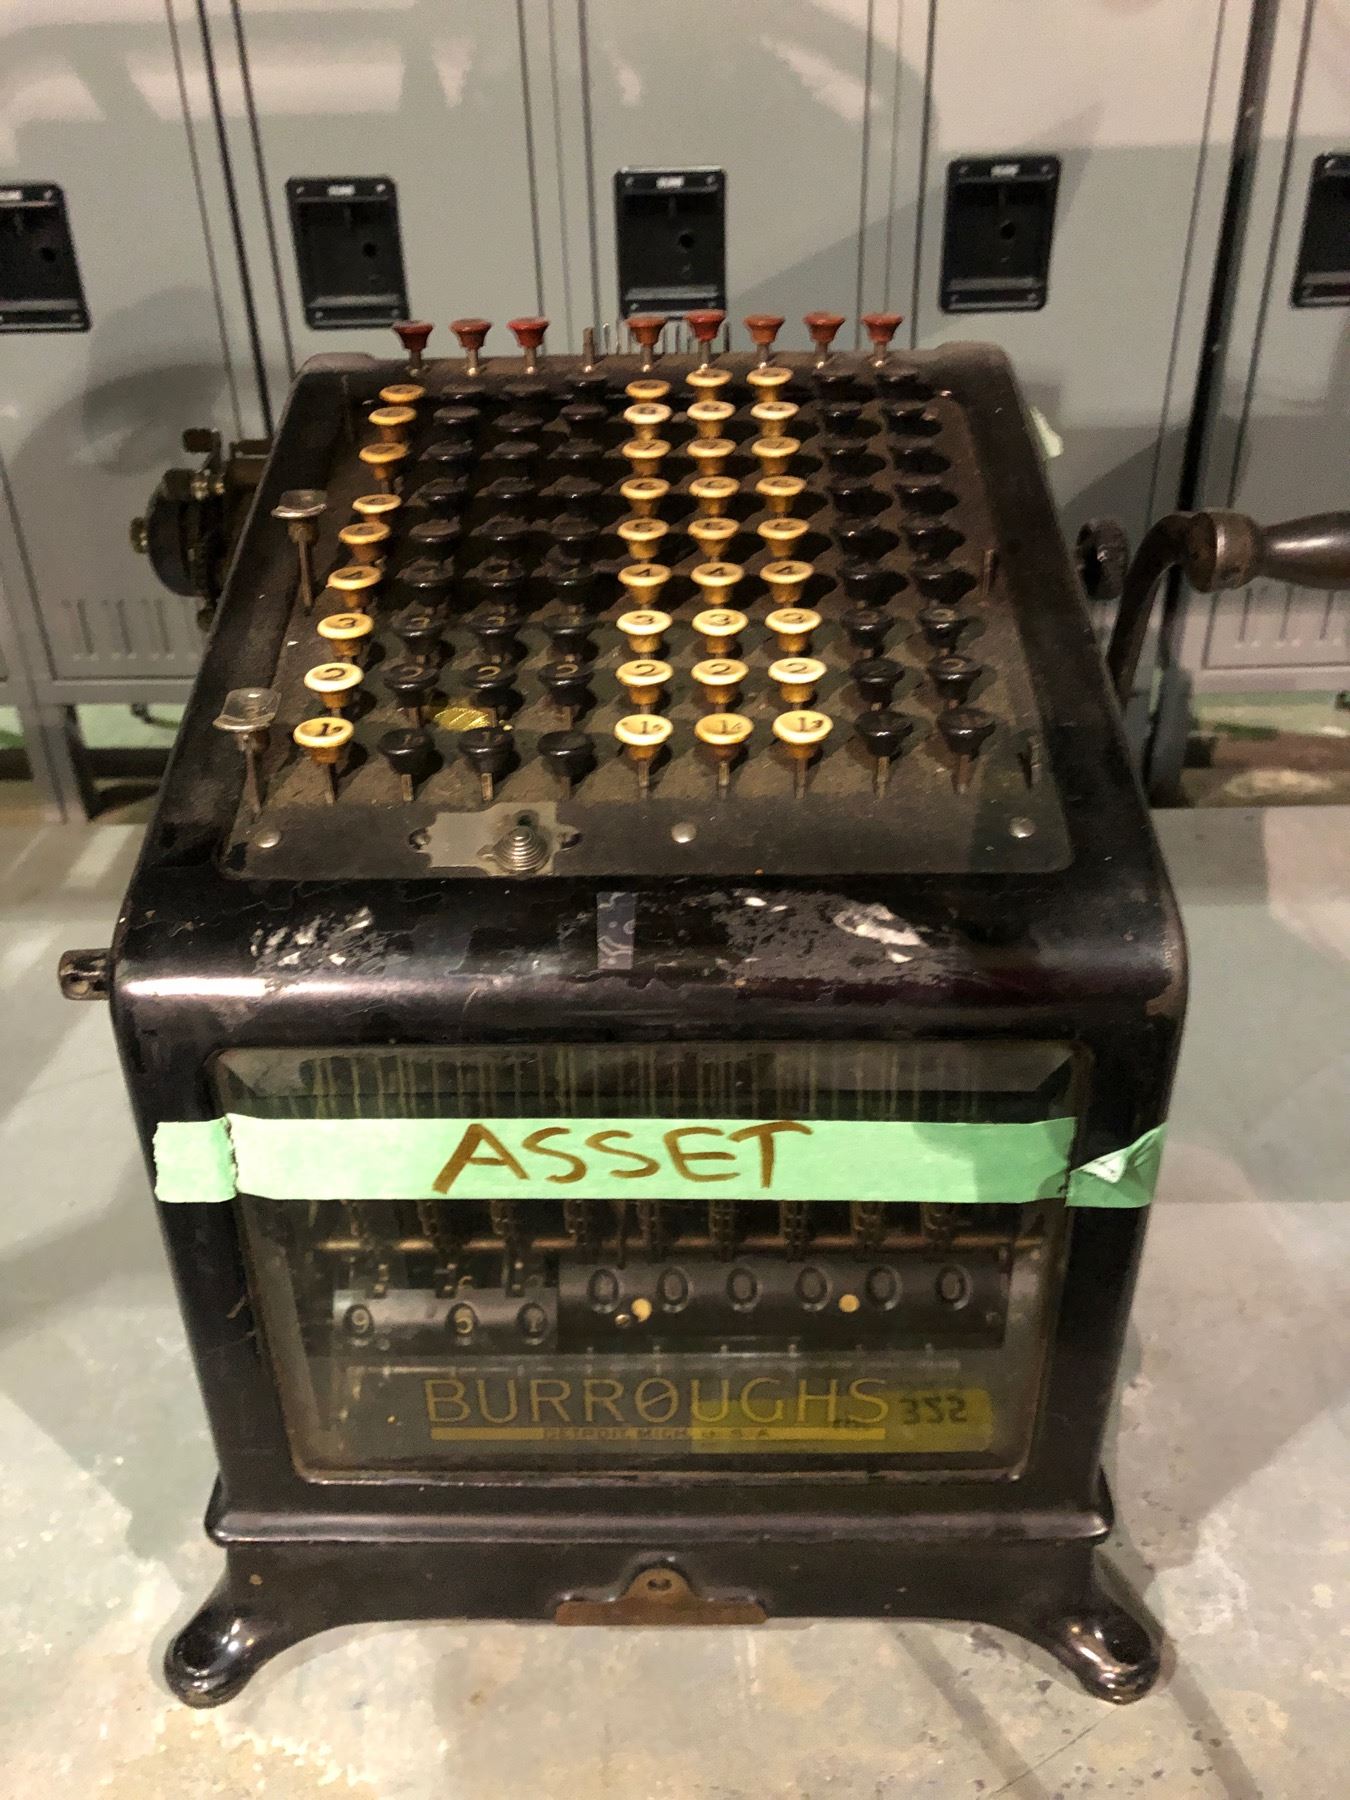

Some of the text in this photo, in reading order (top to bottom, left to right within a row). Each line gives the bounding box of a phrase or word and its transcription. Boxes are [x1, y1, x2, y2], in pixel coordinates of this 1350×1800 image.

[338, 617, 358, 629] 3
[633, 614, 655, 626] 3
[709, 613, 731, 627] 3
[322, 667, 346, 681] 2
[633, 663, 656, 676] 2
[710, 662, 731, 676] 2
[785, 661, 808, 675] 2
[431, 1120, 814, 1196] ASSET
[351, 1308, 370, 1334] 9
[454, 1306, 474, 1335] 5
[423, 1376, 889, 1424] BURROUGHS
